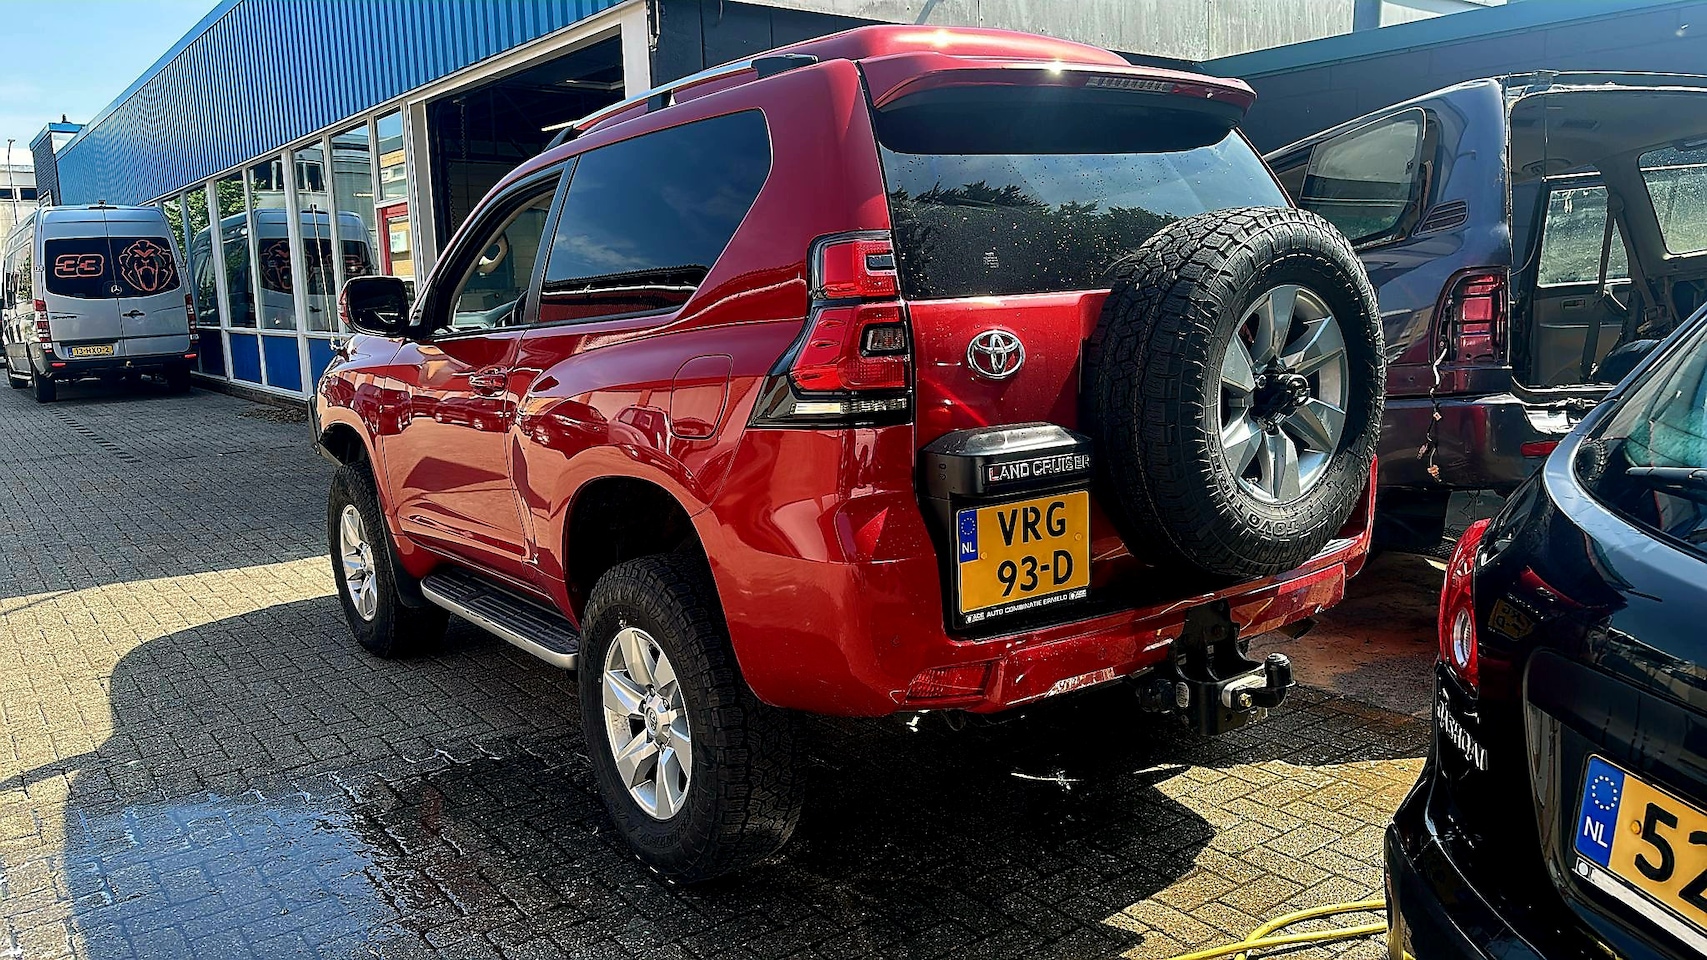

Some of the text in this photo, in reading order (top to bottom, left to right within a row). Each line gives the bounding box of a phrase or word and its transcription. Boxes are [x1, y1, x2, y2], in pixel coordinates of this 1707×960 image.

[55, 254, 104, 278] 33
[988, 454, 1090, 482] LAND CRUISER
[997, 501, 1067, 546] VRG
[961, 541, 977, 555] NL
[997, 549, 1073, 598] 93-D
[986, 608, 1004, 619] AUTO
[1004, 600, 1042, 614] COMBINATIE
[1042, 593, 1068, 605] ERMELO
[1583, 815, 1608, 849] NL
